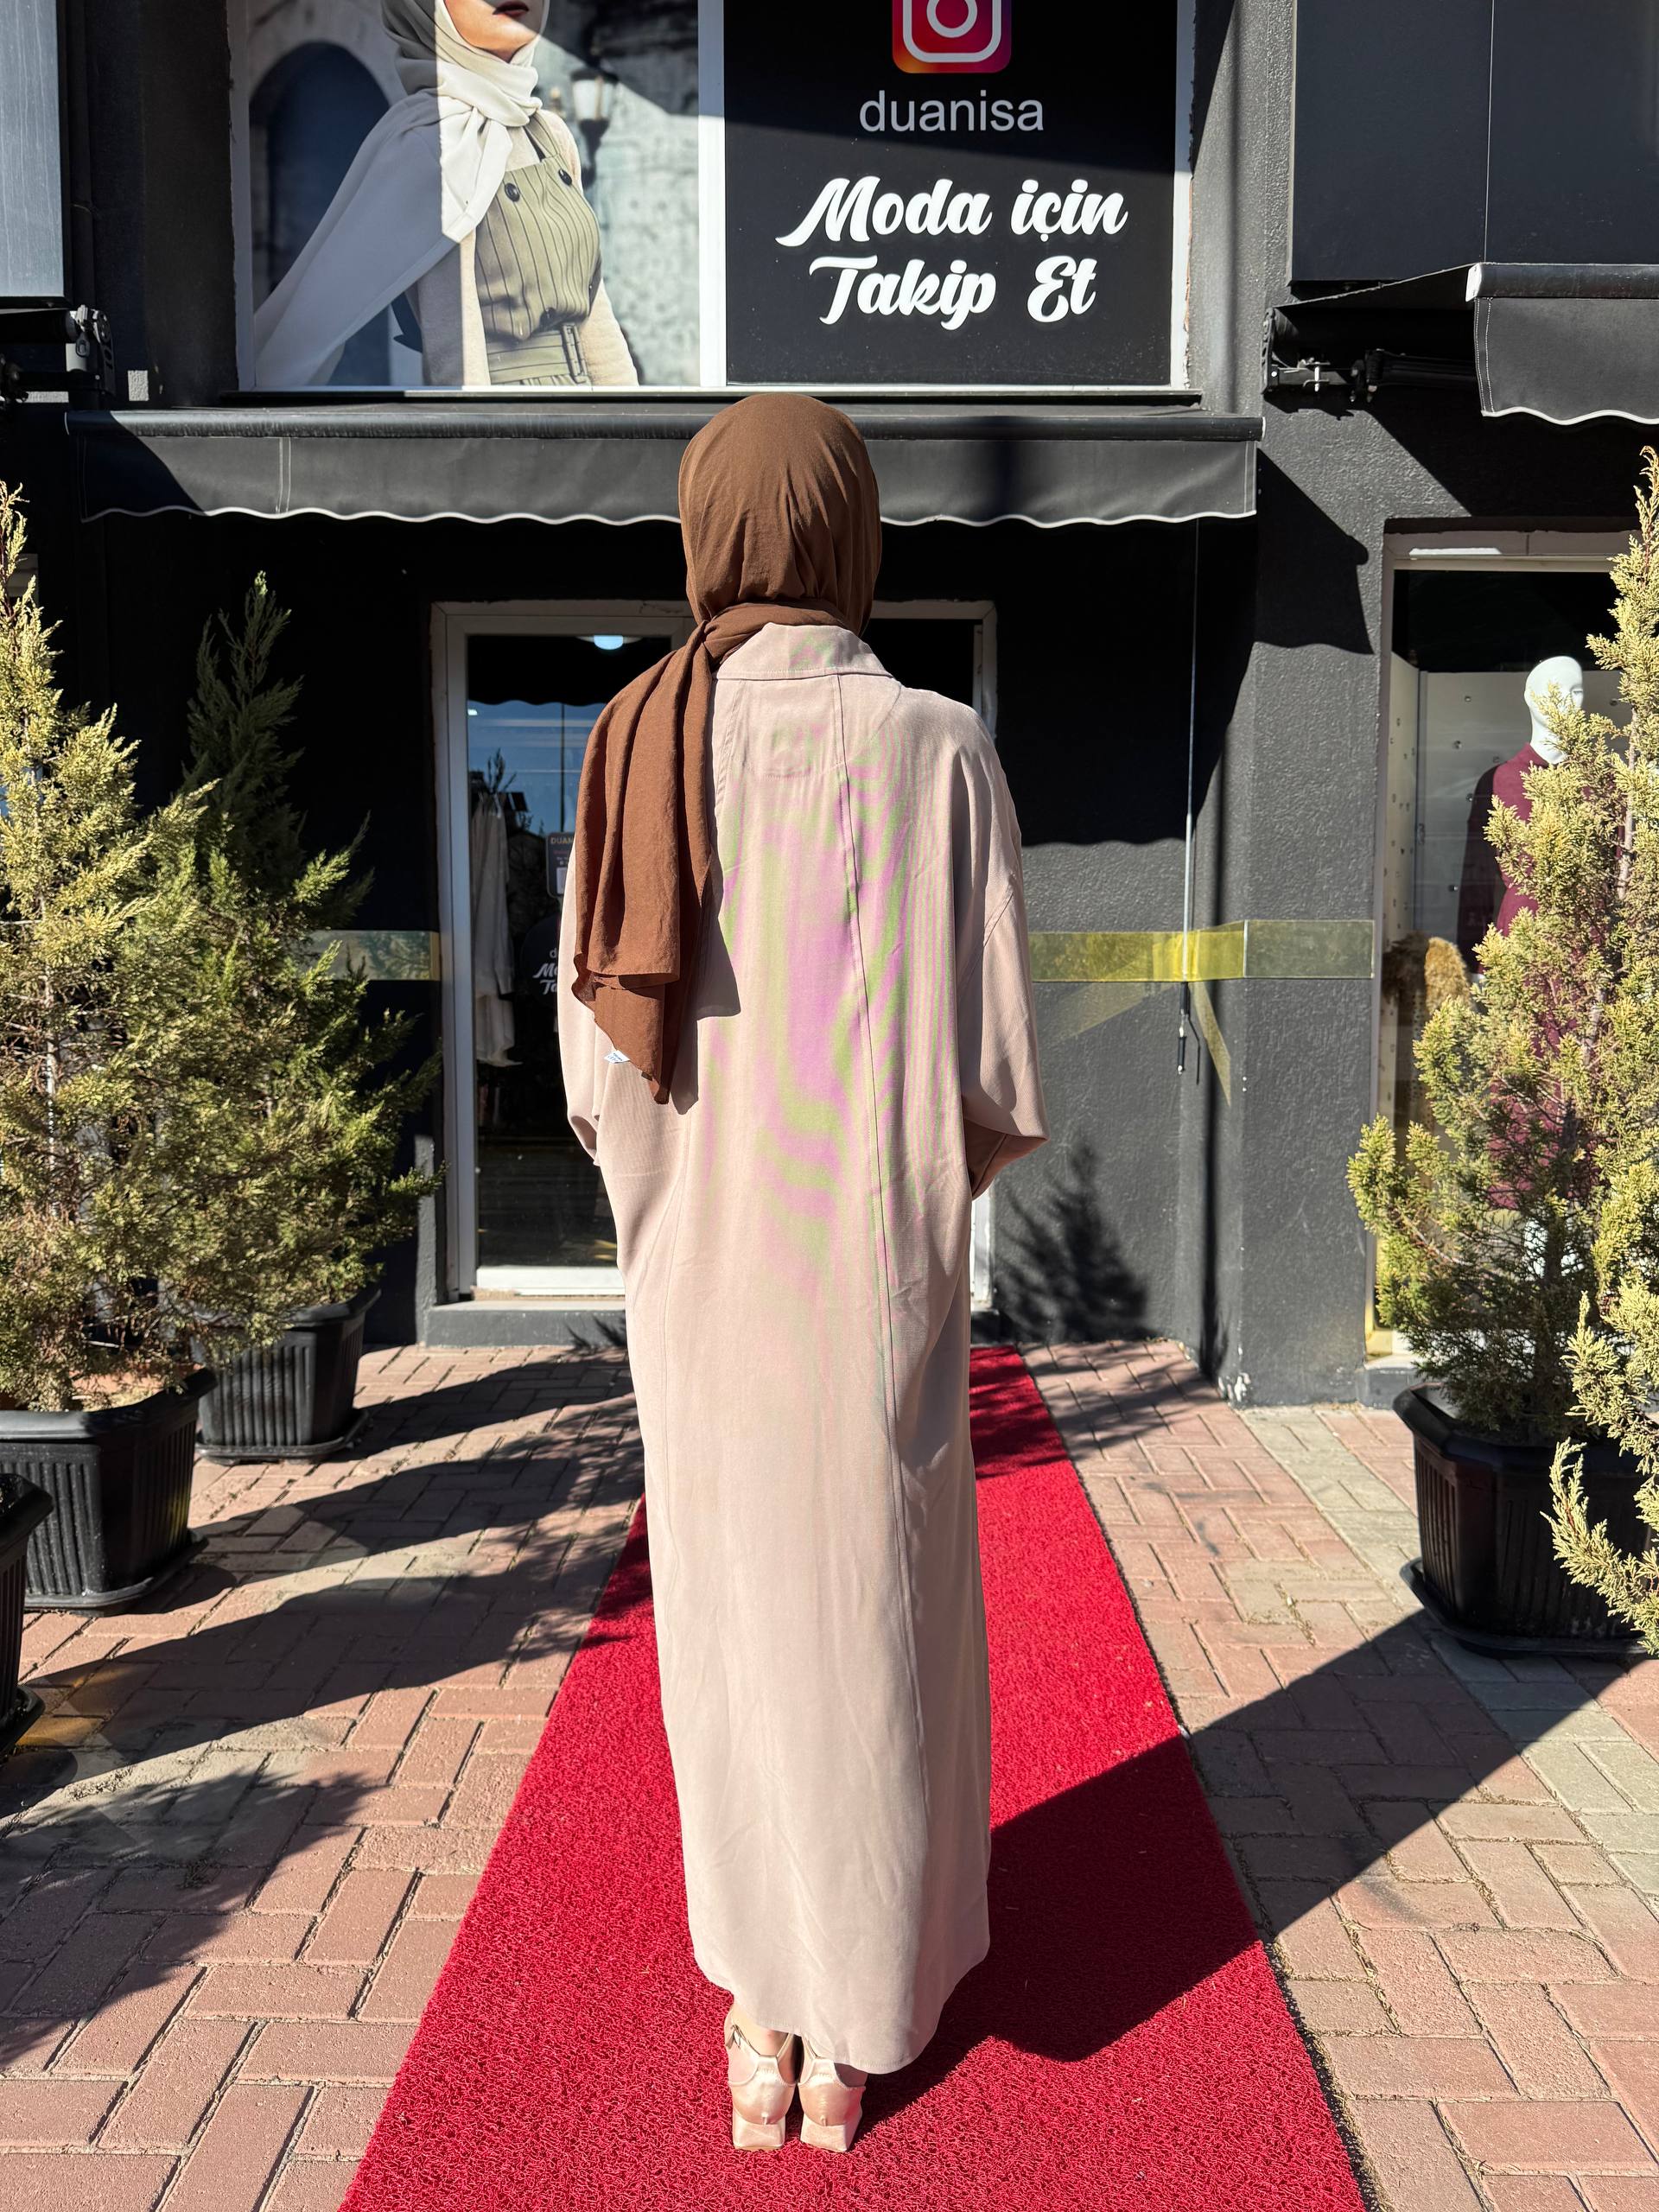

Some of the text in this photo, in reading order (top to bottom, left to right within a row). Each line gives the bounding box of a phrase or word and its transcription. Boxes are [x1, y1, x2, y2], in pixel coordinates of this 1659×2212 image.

[860, 90, 1044, 131] duanisa
[775, 175, 1128, 246] Moda için
[809, 255, 1097, 330] Takip Et
